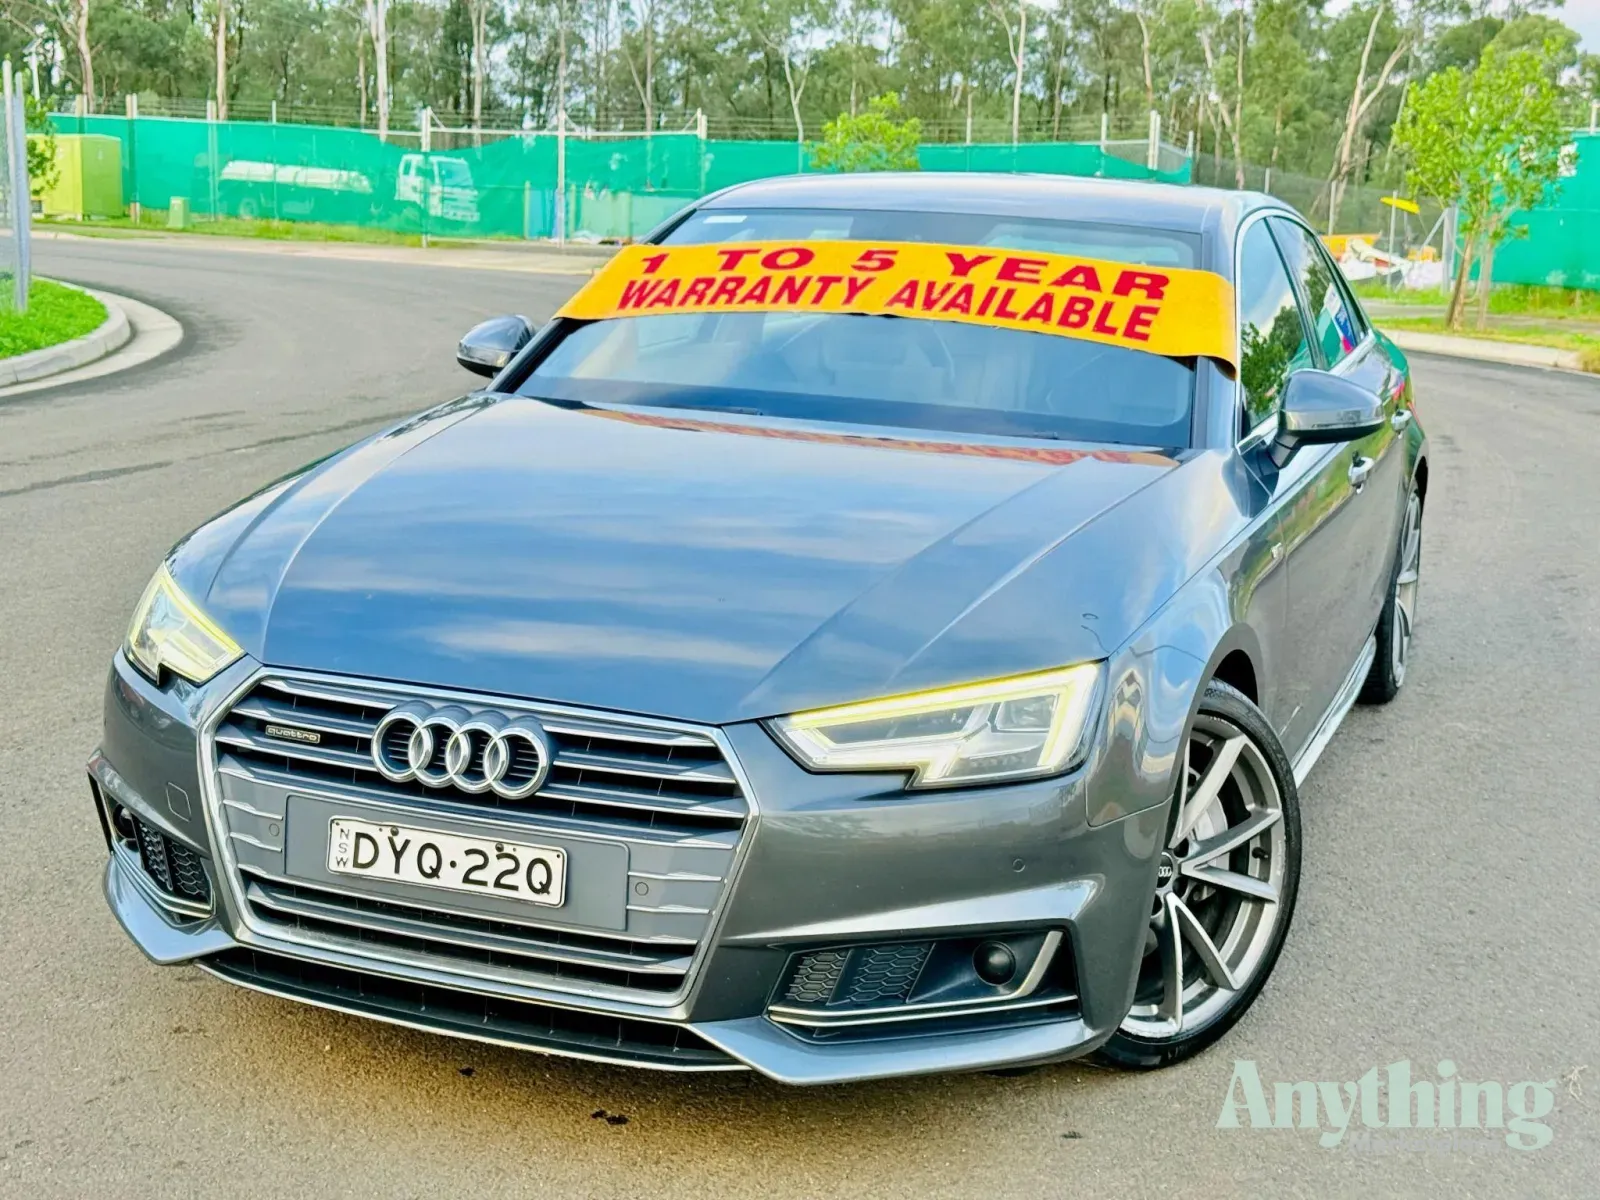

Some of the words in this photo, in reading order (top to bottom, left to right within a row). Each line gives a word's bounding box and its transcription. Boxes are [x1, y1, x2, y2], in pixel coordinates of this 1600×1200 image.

[641, 253, 669, 274] 1
[717, 248, 815, 271] TO
[851, 250, 898, 272] 5
[945, 252, 1170, 300] YEAR
[617, 275, 877, 310] WARRANTY
[884, 279, 1161, 341] AVAILABLE
[267, 727, 318, 741] quattro
